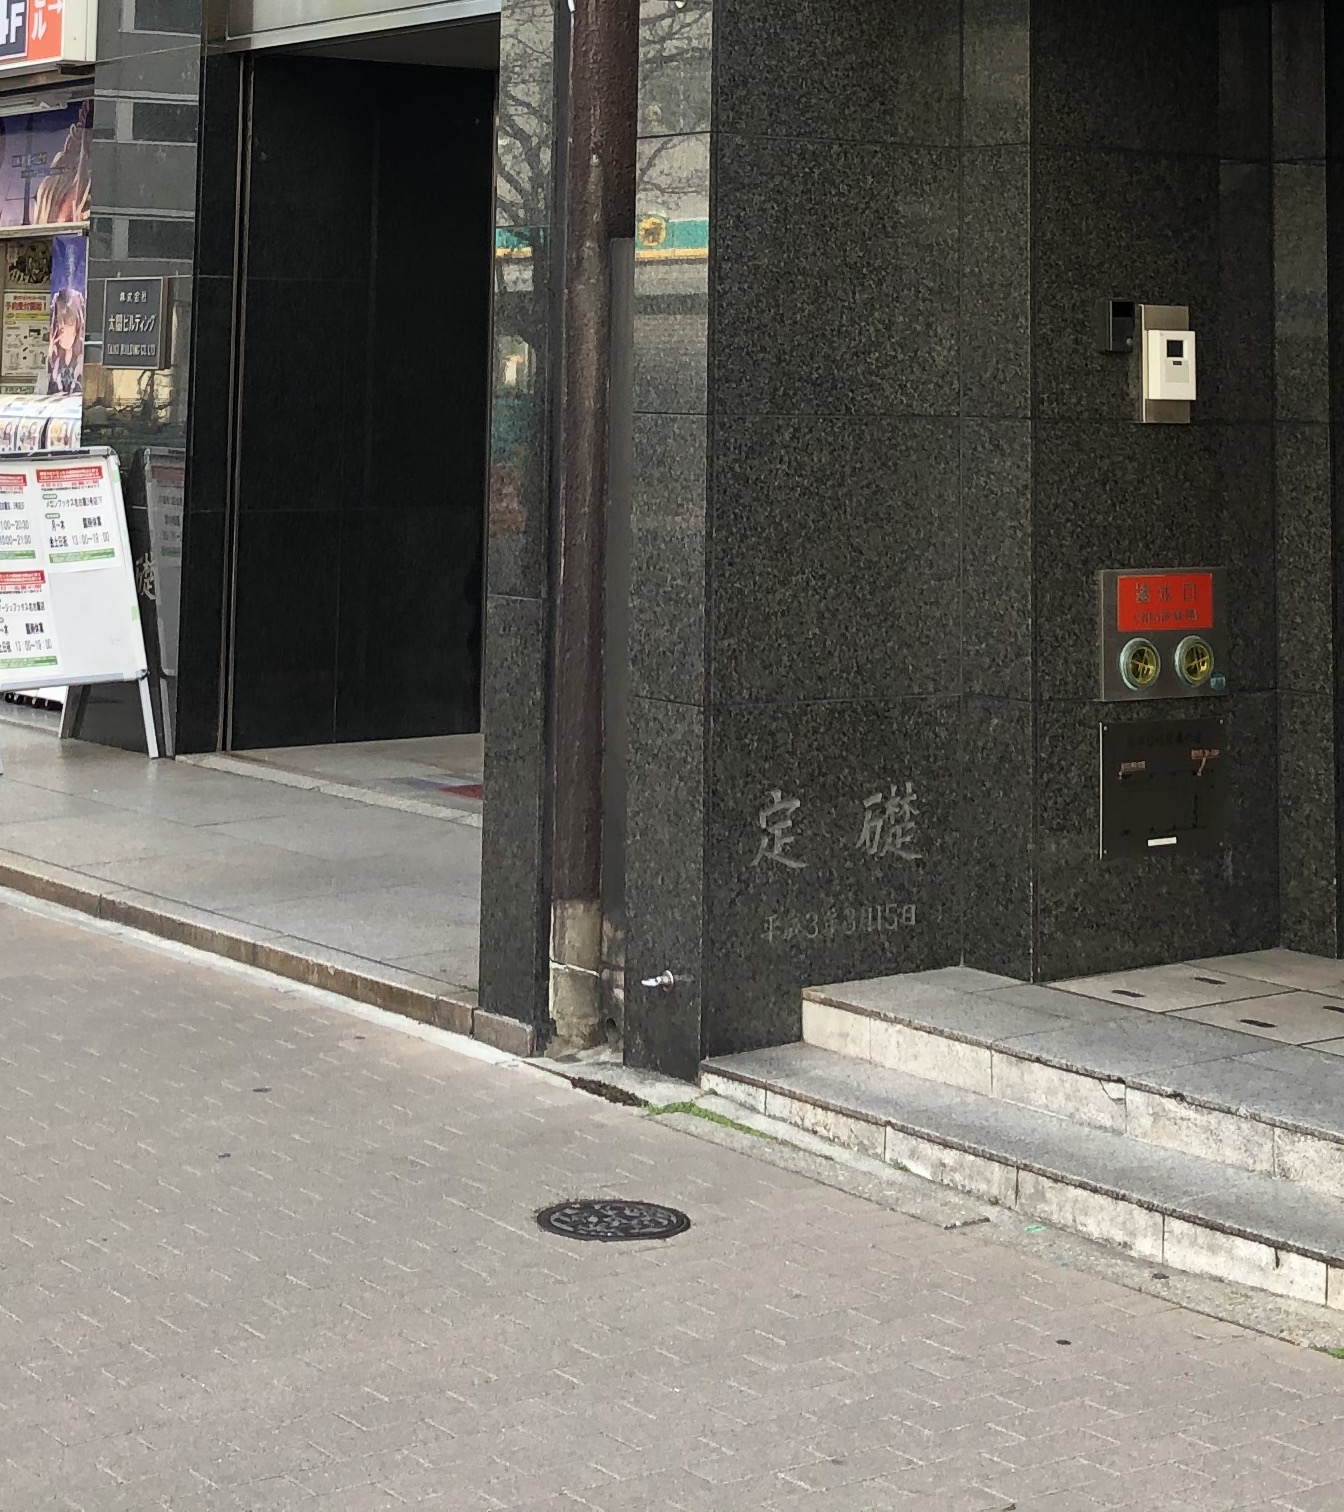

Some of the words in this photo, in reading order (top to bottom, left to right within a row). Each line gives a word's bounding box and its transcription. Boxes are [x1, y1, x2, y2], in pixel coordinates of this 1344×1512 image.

[119, 290, 147, 303] 株式会社
[108, 314, 157, 332] 太閤ビルディング
[750, 781, 923, 868] 定礎
